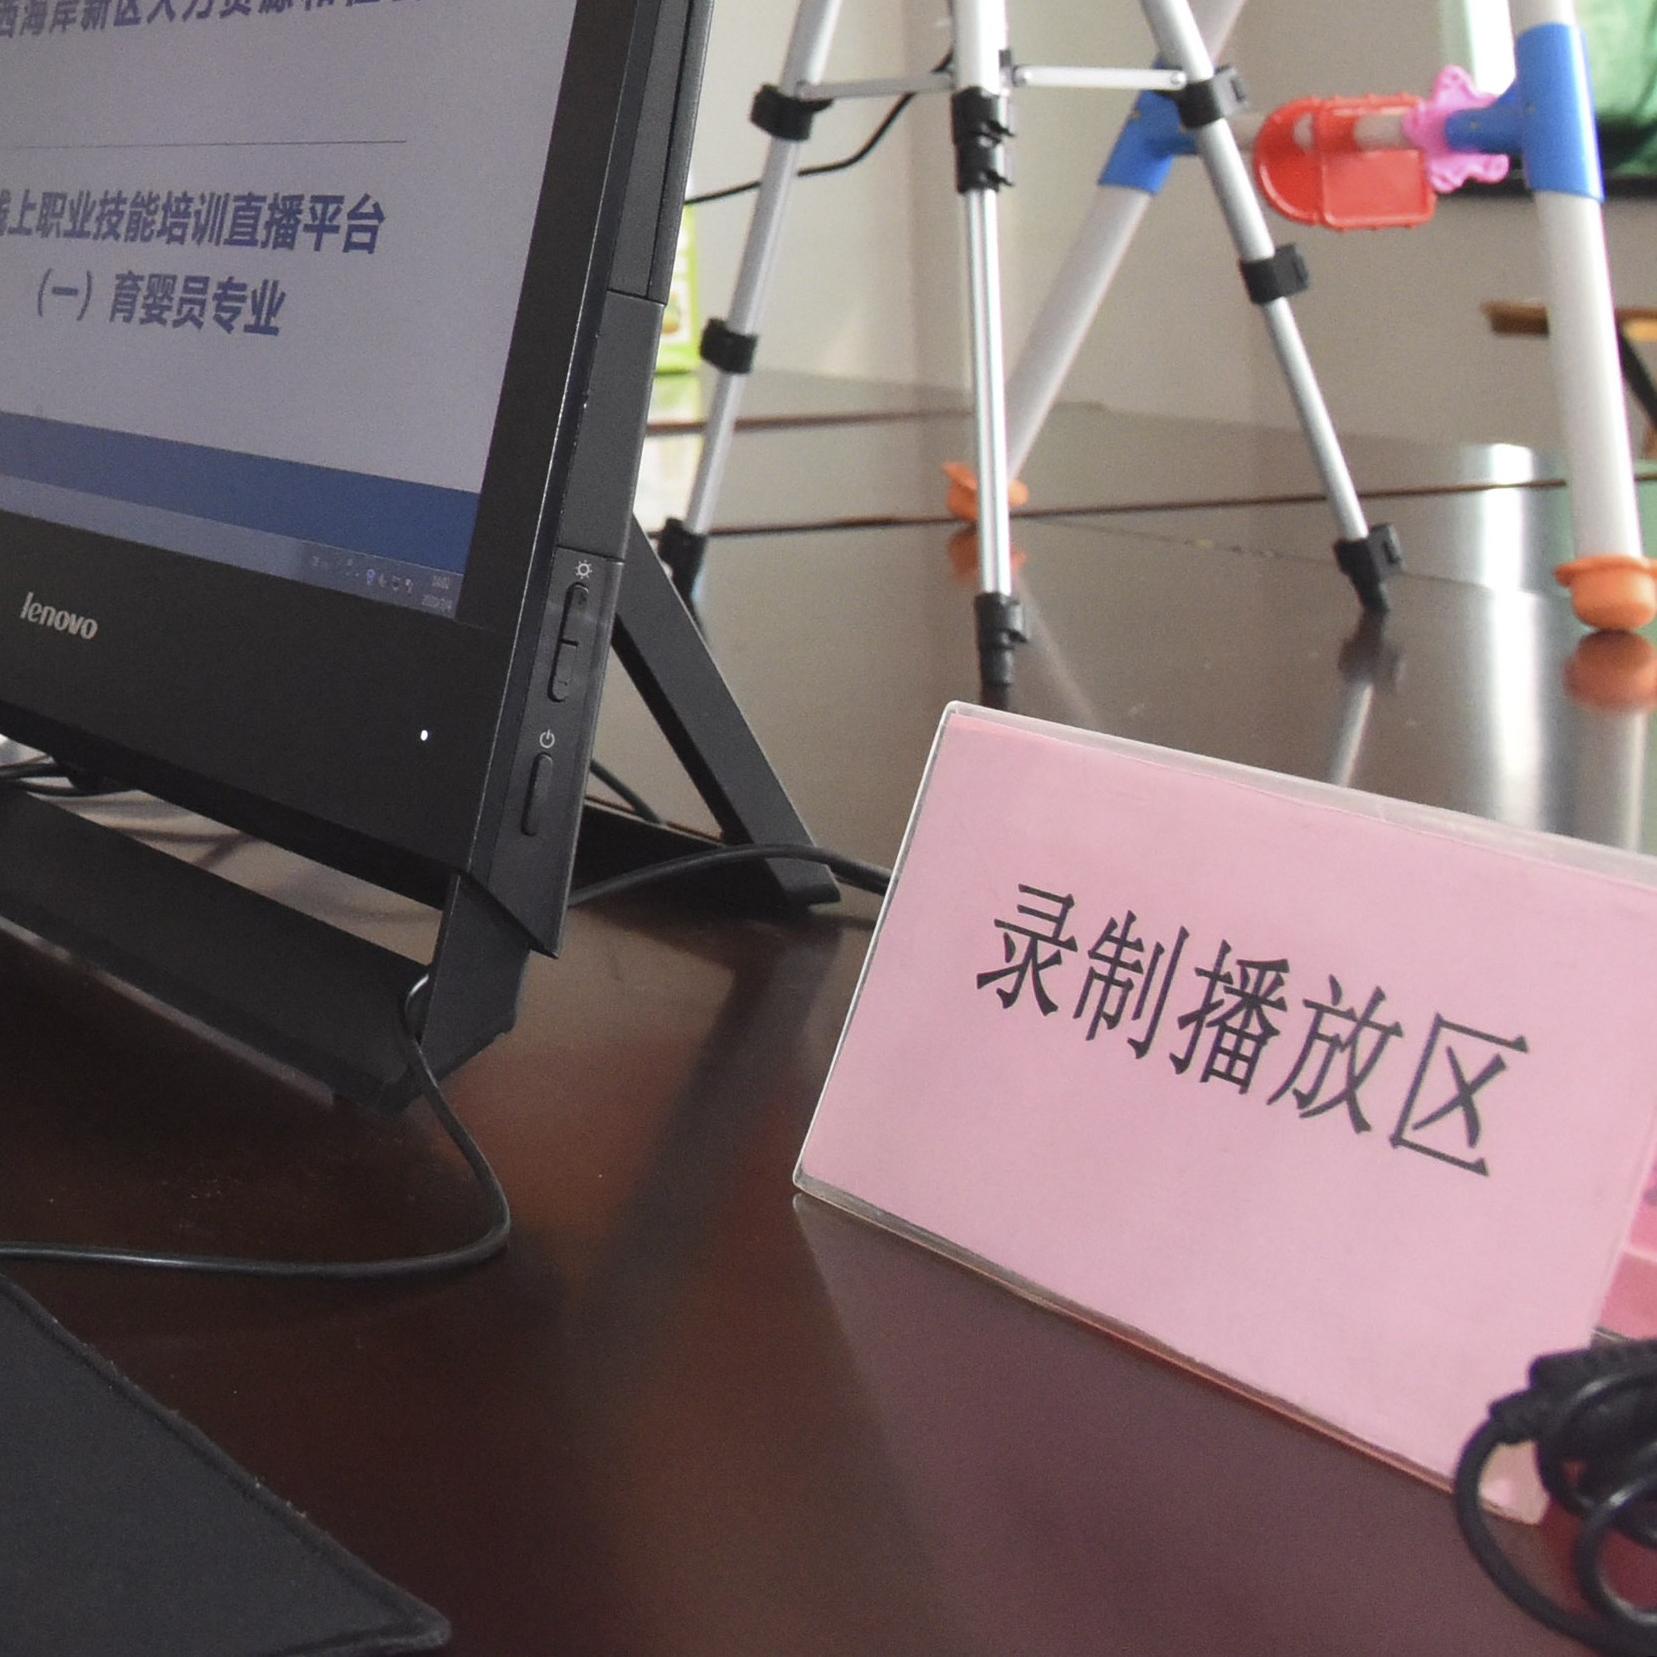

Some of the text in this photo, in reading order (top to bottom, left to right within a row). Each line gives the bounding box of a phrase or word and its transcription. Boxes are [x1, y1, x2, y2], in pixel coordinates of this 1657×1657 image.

[19, 591, 99, 640] lenovo
[976, 882, 1529, 1176] 录制播放区
